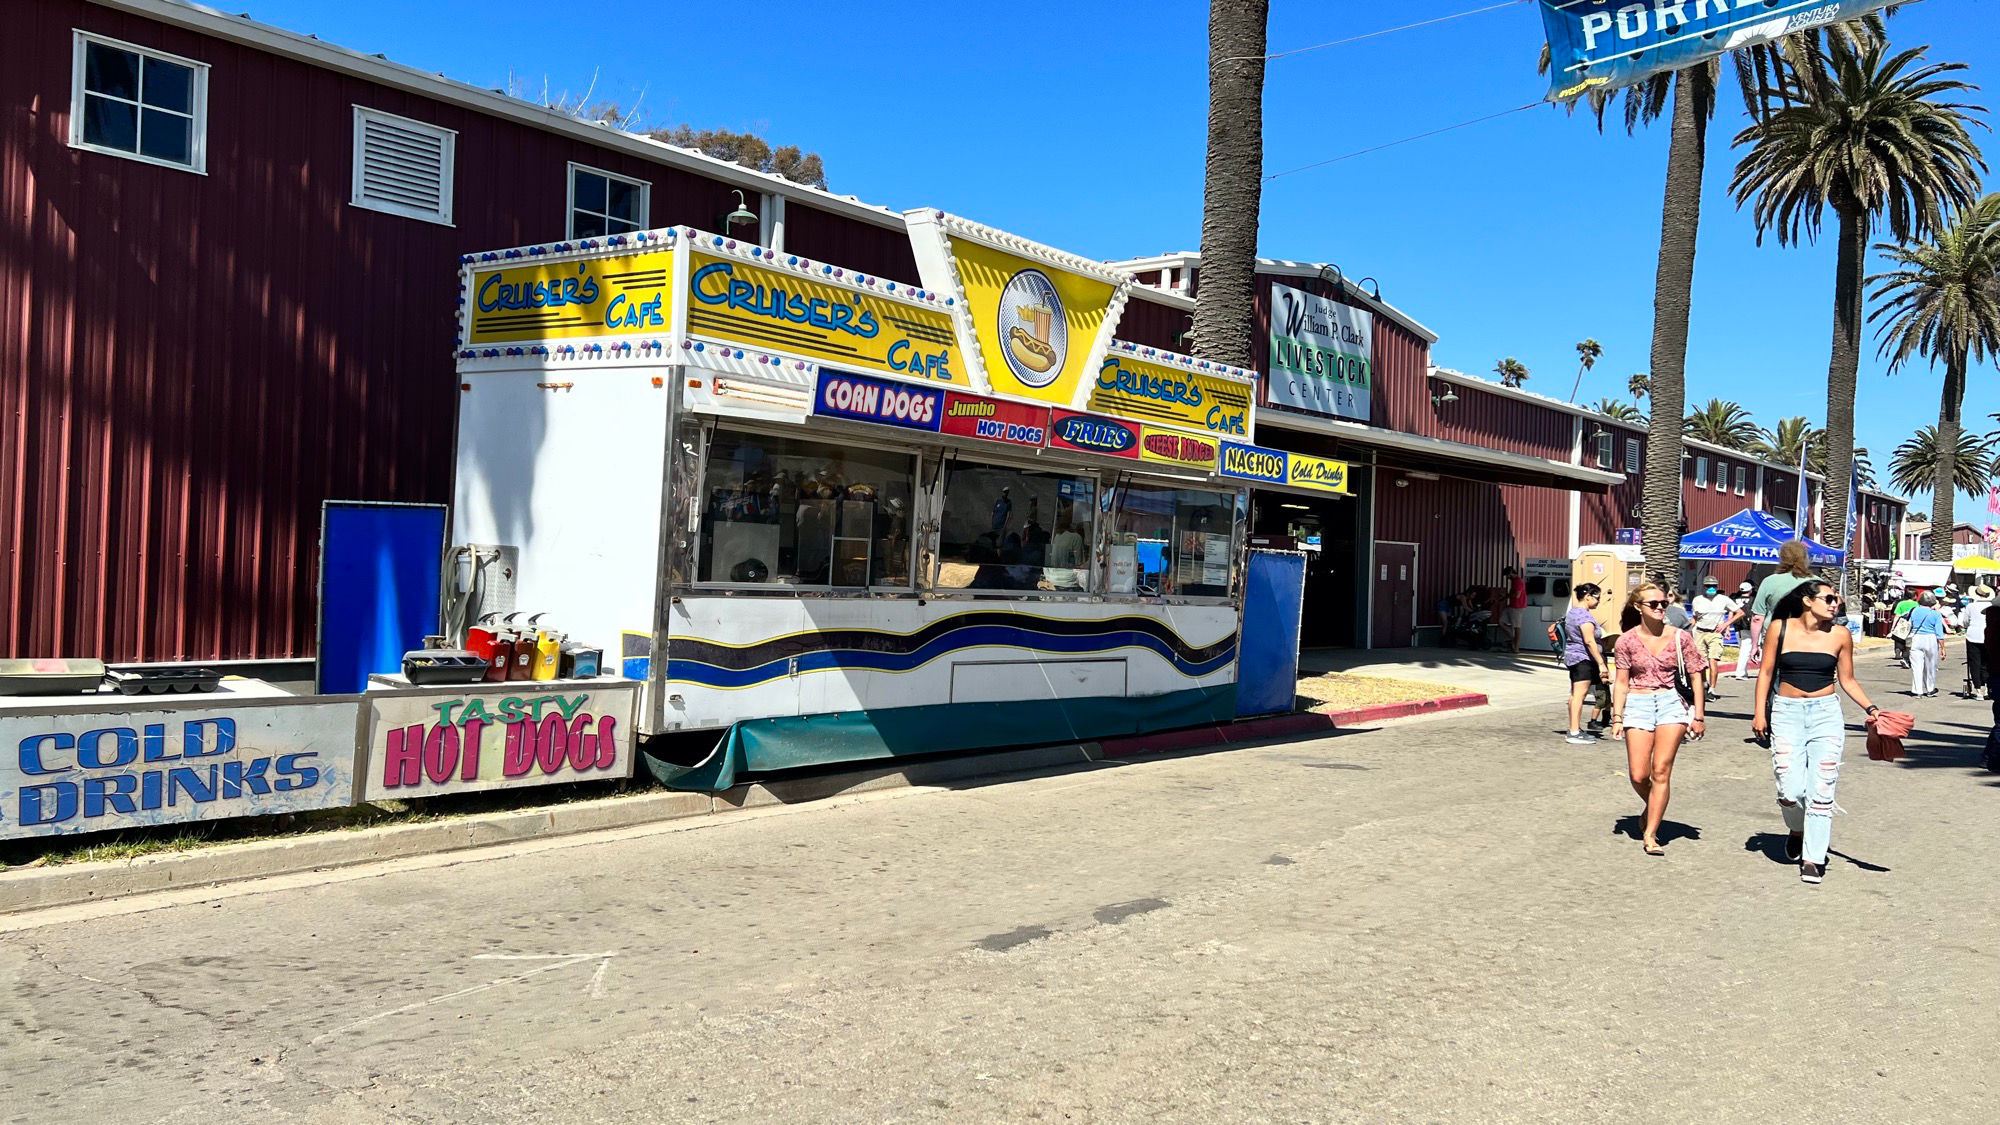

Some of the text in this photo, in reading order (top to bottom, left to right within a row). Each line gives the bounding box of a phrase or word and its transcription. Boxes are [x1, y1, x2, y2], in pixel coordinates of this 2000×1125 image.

[1791, 2, 1840, 22] VENTURA
[606, 293, 664, 329] CAFÉ
[1282, 292, 1364, 347] William P. Clark
[1314, 303, 1337, 318] Judge
[887, 339, 952, 381] CAFÉ
[1277, 340, 1366, 385] LIVESTOCK
[824, 379, 936, 424] CORN DOGS
[948, 399, 996, 418] Jumbo
[1288, 380, 1354, 408] CENTER
[976, 419, 1043, 444] HOT DOGS
[1062, 418, 1130, 450] FRIES
[1206, 405, 1246, 435] CAFÉ
[1144, 433, 1215, 462] CHEESE BURGER
[1225, 446, 1284, 478] NACHOS
[1291, 460, 1345, 483] Cold Drinks
[1712, 526, 1762, 538] ULTRA
[1678, 544, 1780, 558] Michelob ULTRA
[432, 693, 589, 727] TASTY
[19, 717, 236, 776] COLD
[384, 712, 617, 788] HOT DOGS
[19, 751, 319, 827] DRINKS
